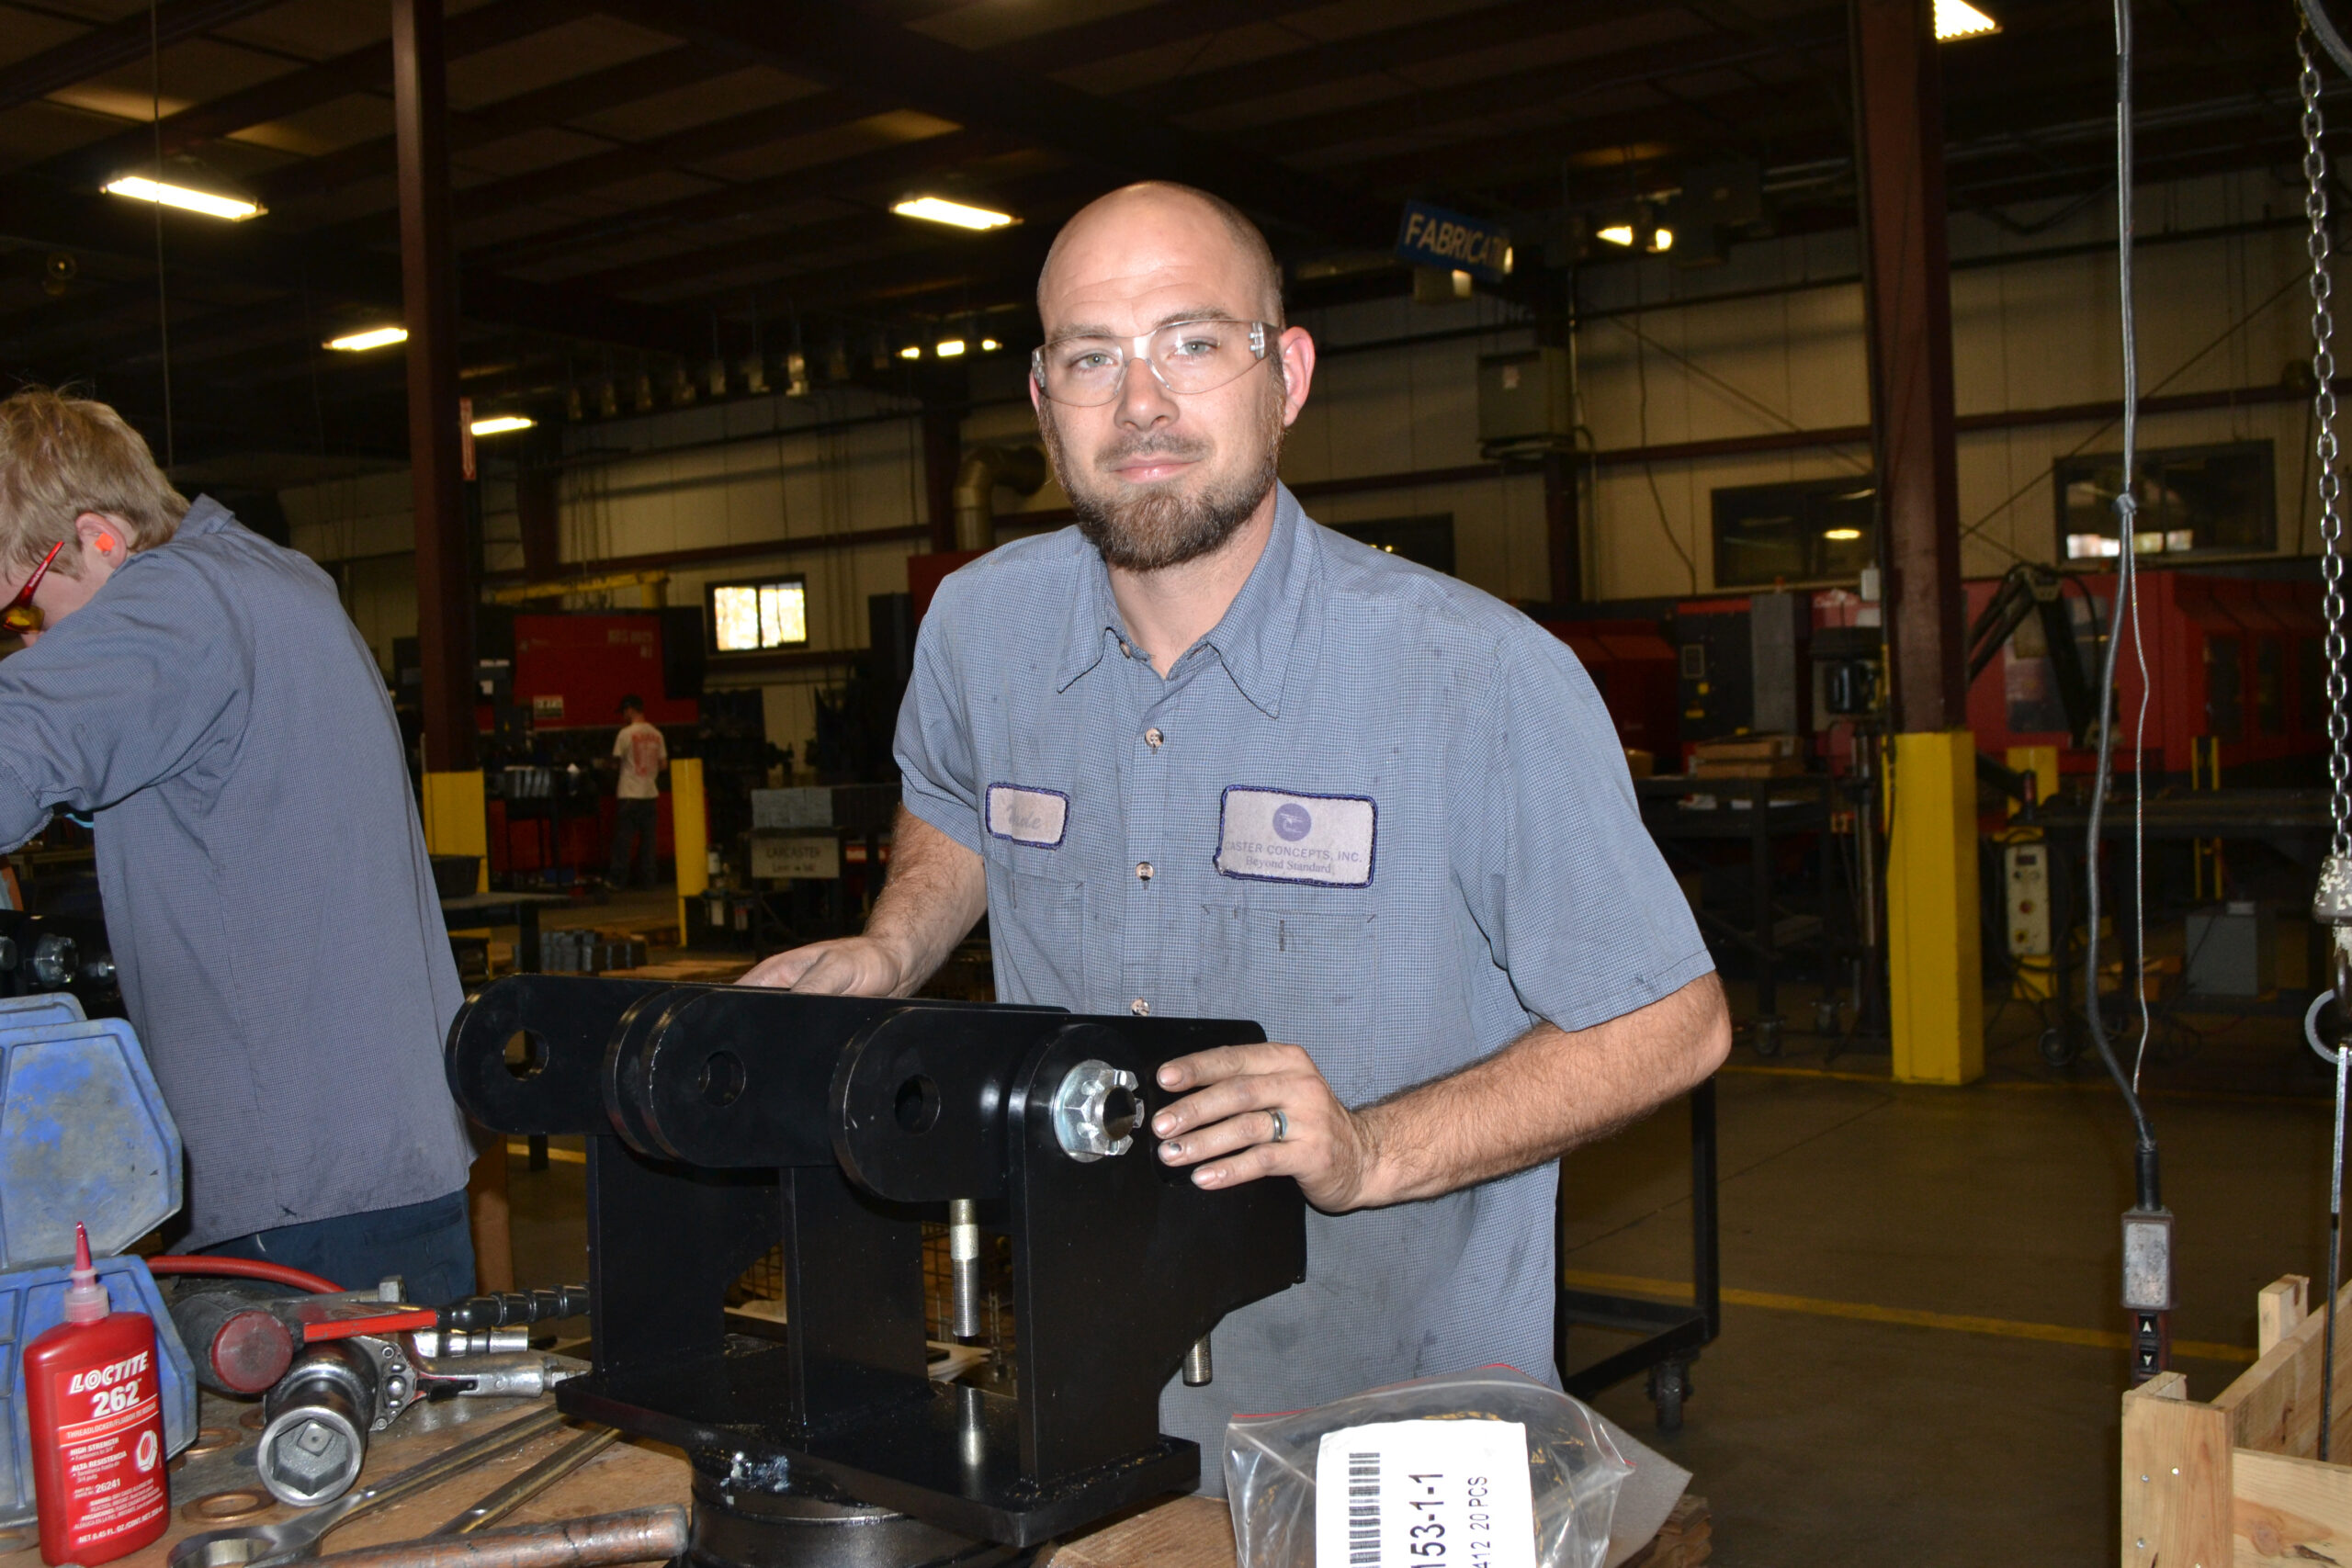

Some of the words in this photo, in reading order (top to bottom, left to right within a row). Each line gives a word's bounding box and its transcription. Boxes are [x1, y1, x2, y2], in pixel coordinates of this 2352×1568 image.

[1225, 840, 1263, 854] CASTER
[1266, 845, 1334, 861] CONCEPTS,
[1338, 851, 1363, 863] INC.
[1246, 855, 1284, 870] Beyond
[1286, 860, 1332, 874] Standard
[68, 1350, 149, 1394] LOCTITE
[91, 1381, 141, 1418] 262
[70, 1445, 87, 1456] HIGH
[72, 1462, 88, 1472] ALTA
[95, 1477, 121, 1494] 26241
[1467, 1475, 1488, 1507] PCS
[1468, 1512, 1490, 1530] 20
[78, 1534, 92, 1544] NET
